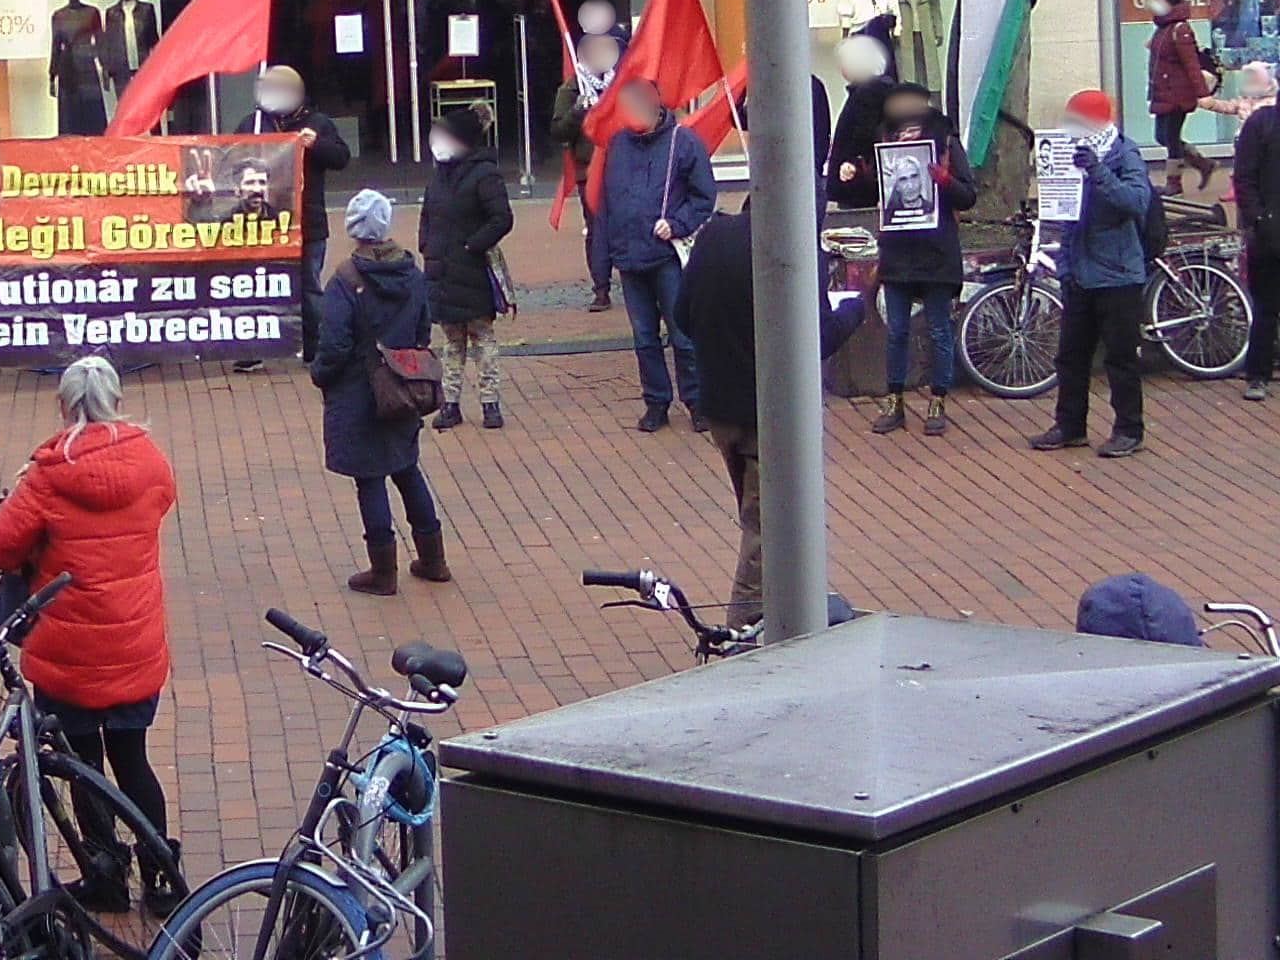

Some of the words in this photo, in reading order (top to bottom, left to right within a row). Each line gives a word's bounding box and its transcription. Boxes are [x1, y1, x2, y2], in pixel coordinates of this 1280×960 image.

[0, 162, 180, 199] Devrimcilik
[101, 210, 292, 253] Görevdir!
[150, 276, 197, 301] zu
[209, 266, 292, 299] sein
[62, 308, 282, 347] Verbrechen
